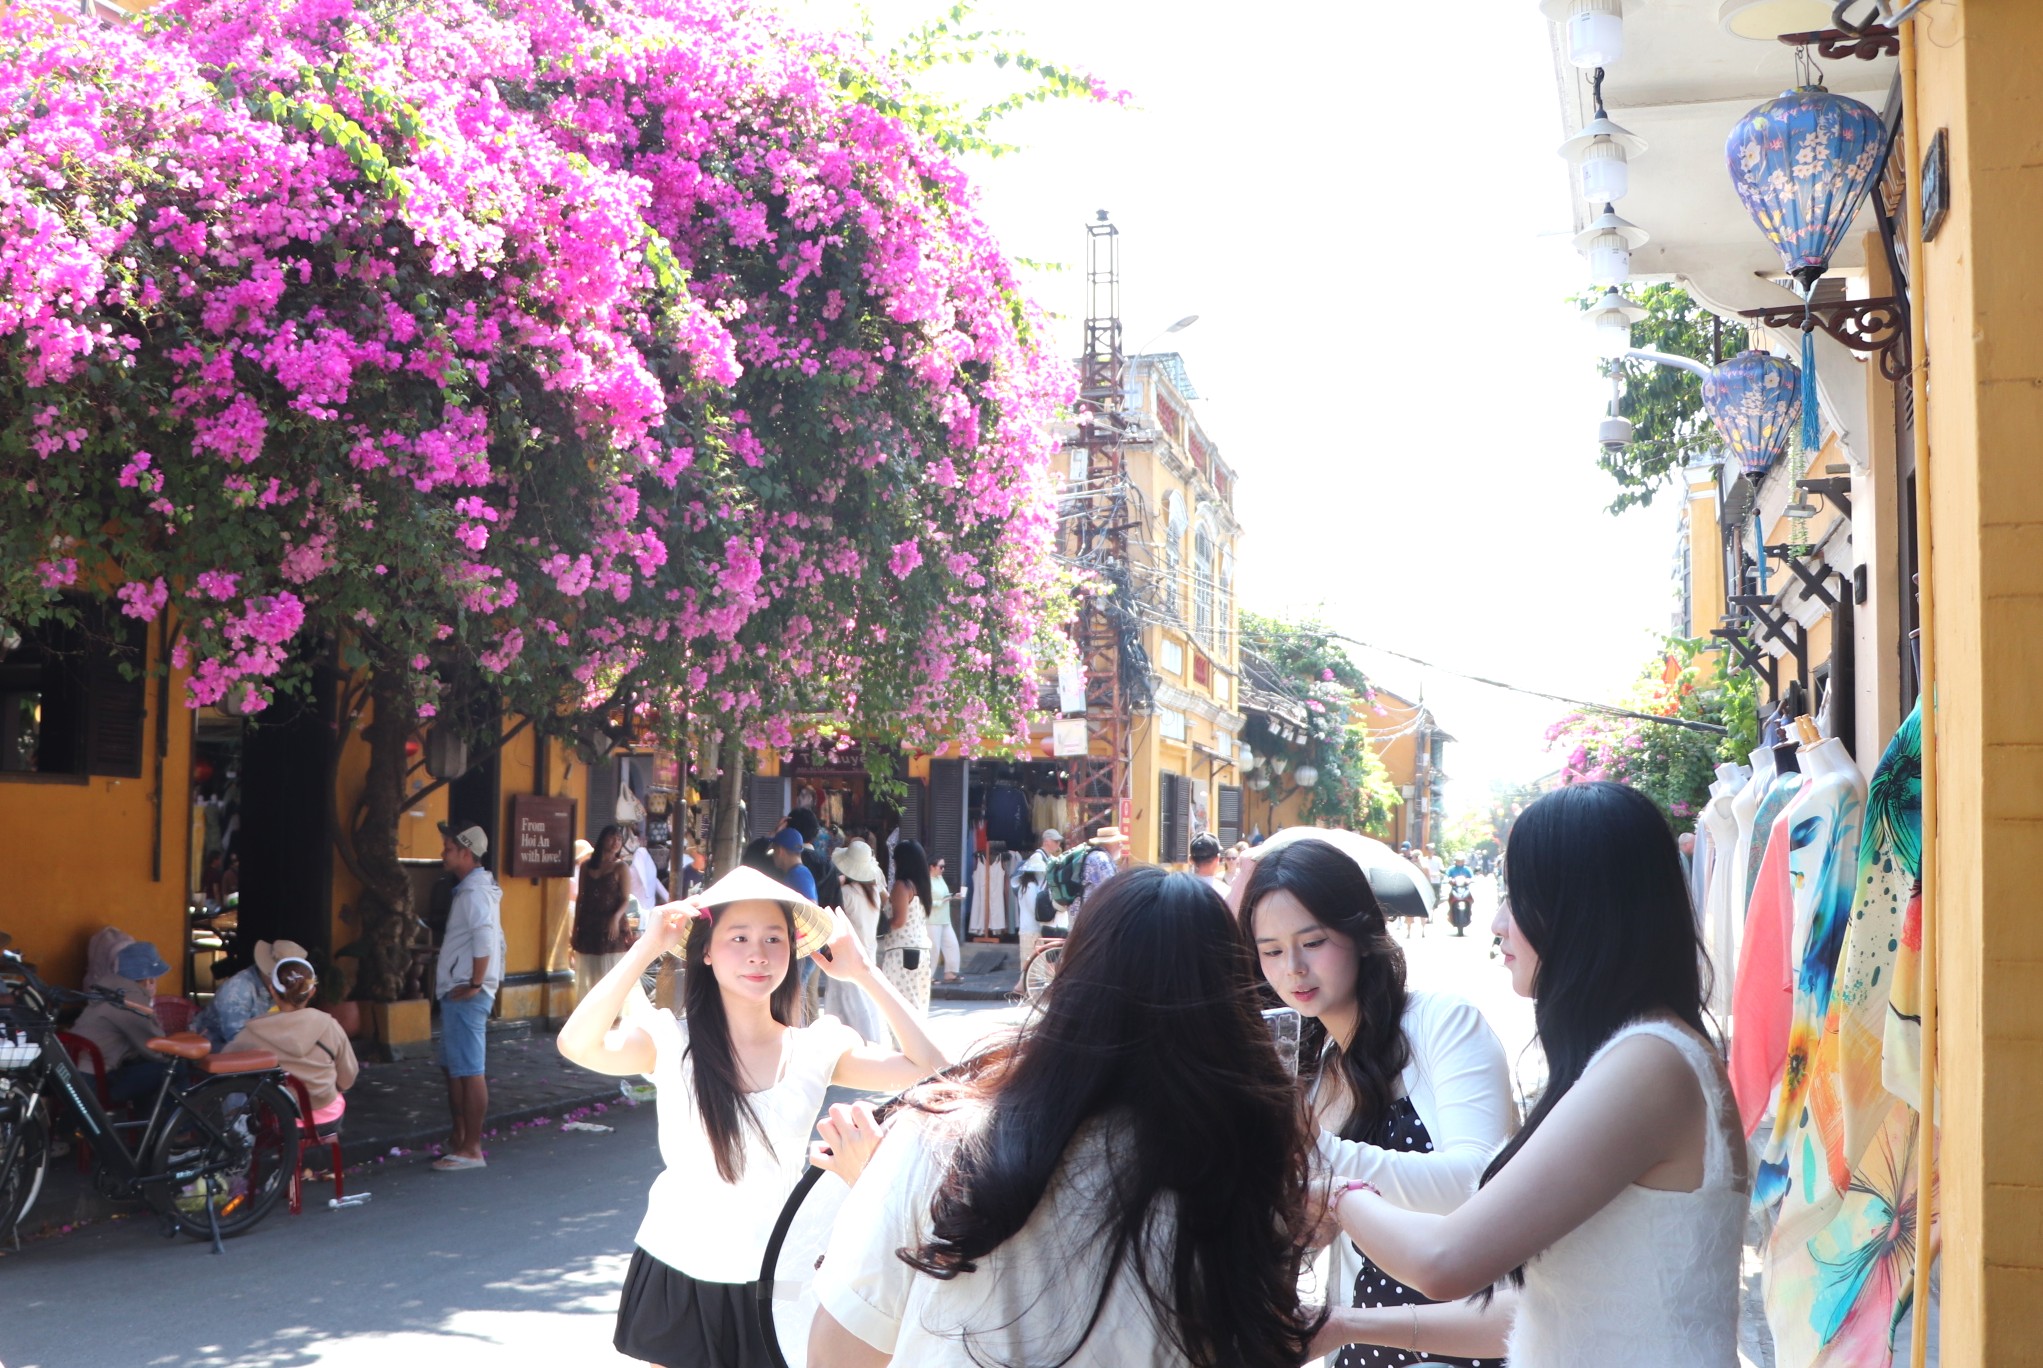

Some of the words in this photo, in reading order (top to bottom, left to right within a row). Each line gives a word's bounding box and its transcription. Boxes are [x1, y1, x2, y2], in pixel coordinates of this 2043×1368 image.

[521, 817, 545, 832] From
[521, 833, 537, 847] Hoi
[538, 835, 550, 847] An
[521, 849, 540, 862] with
[541, 849, 562, 863] love!
